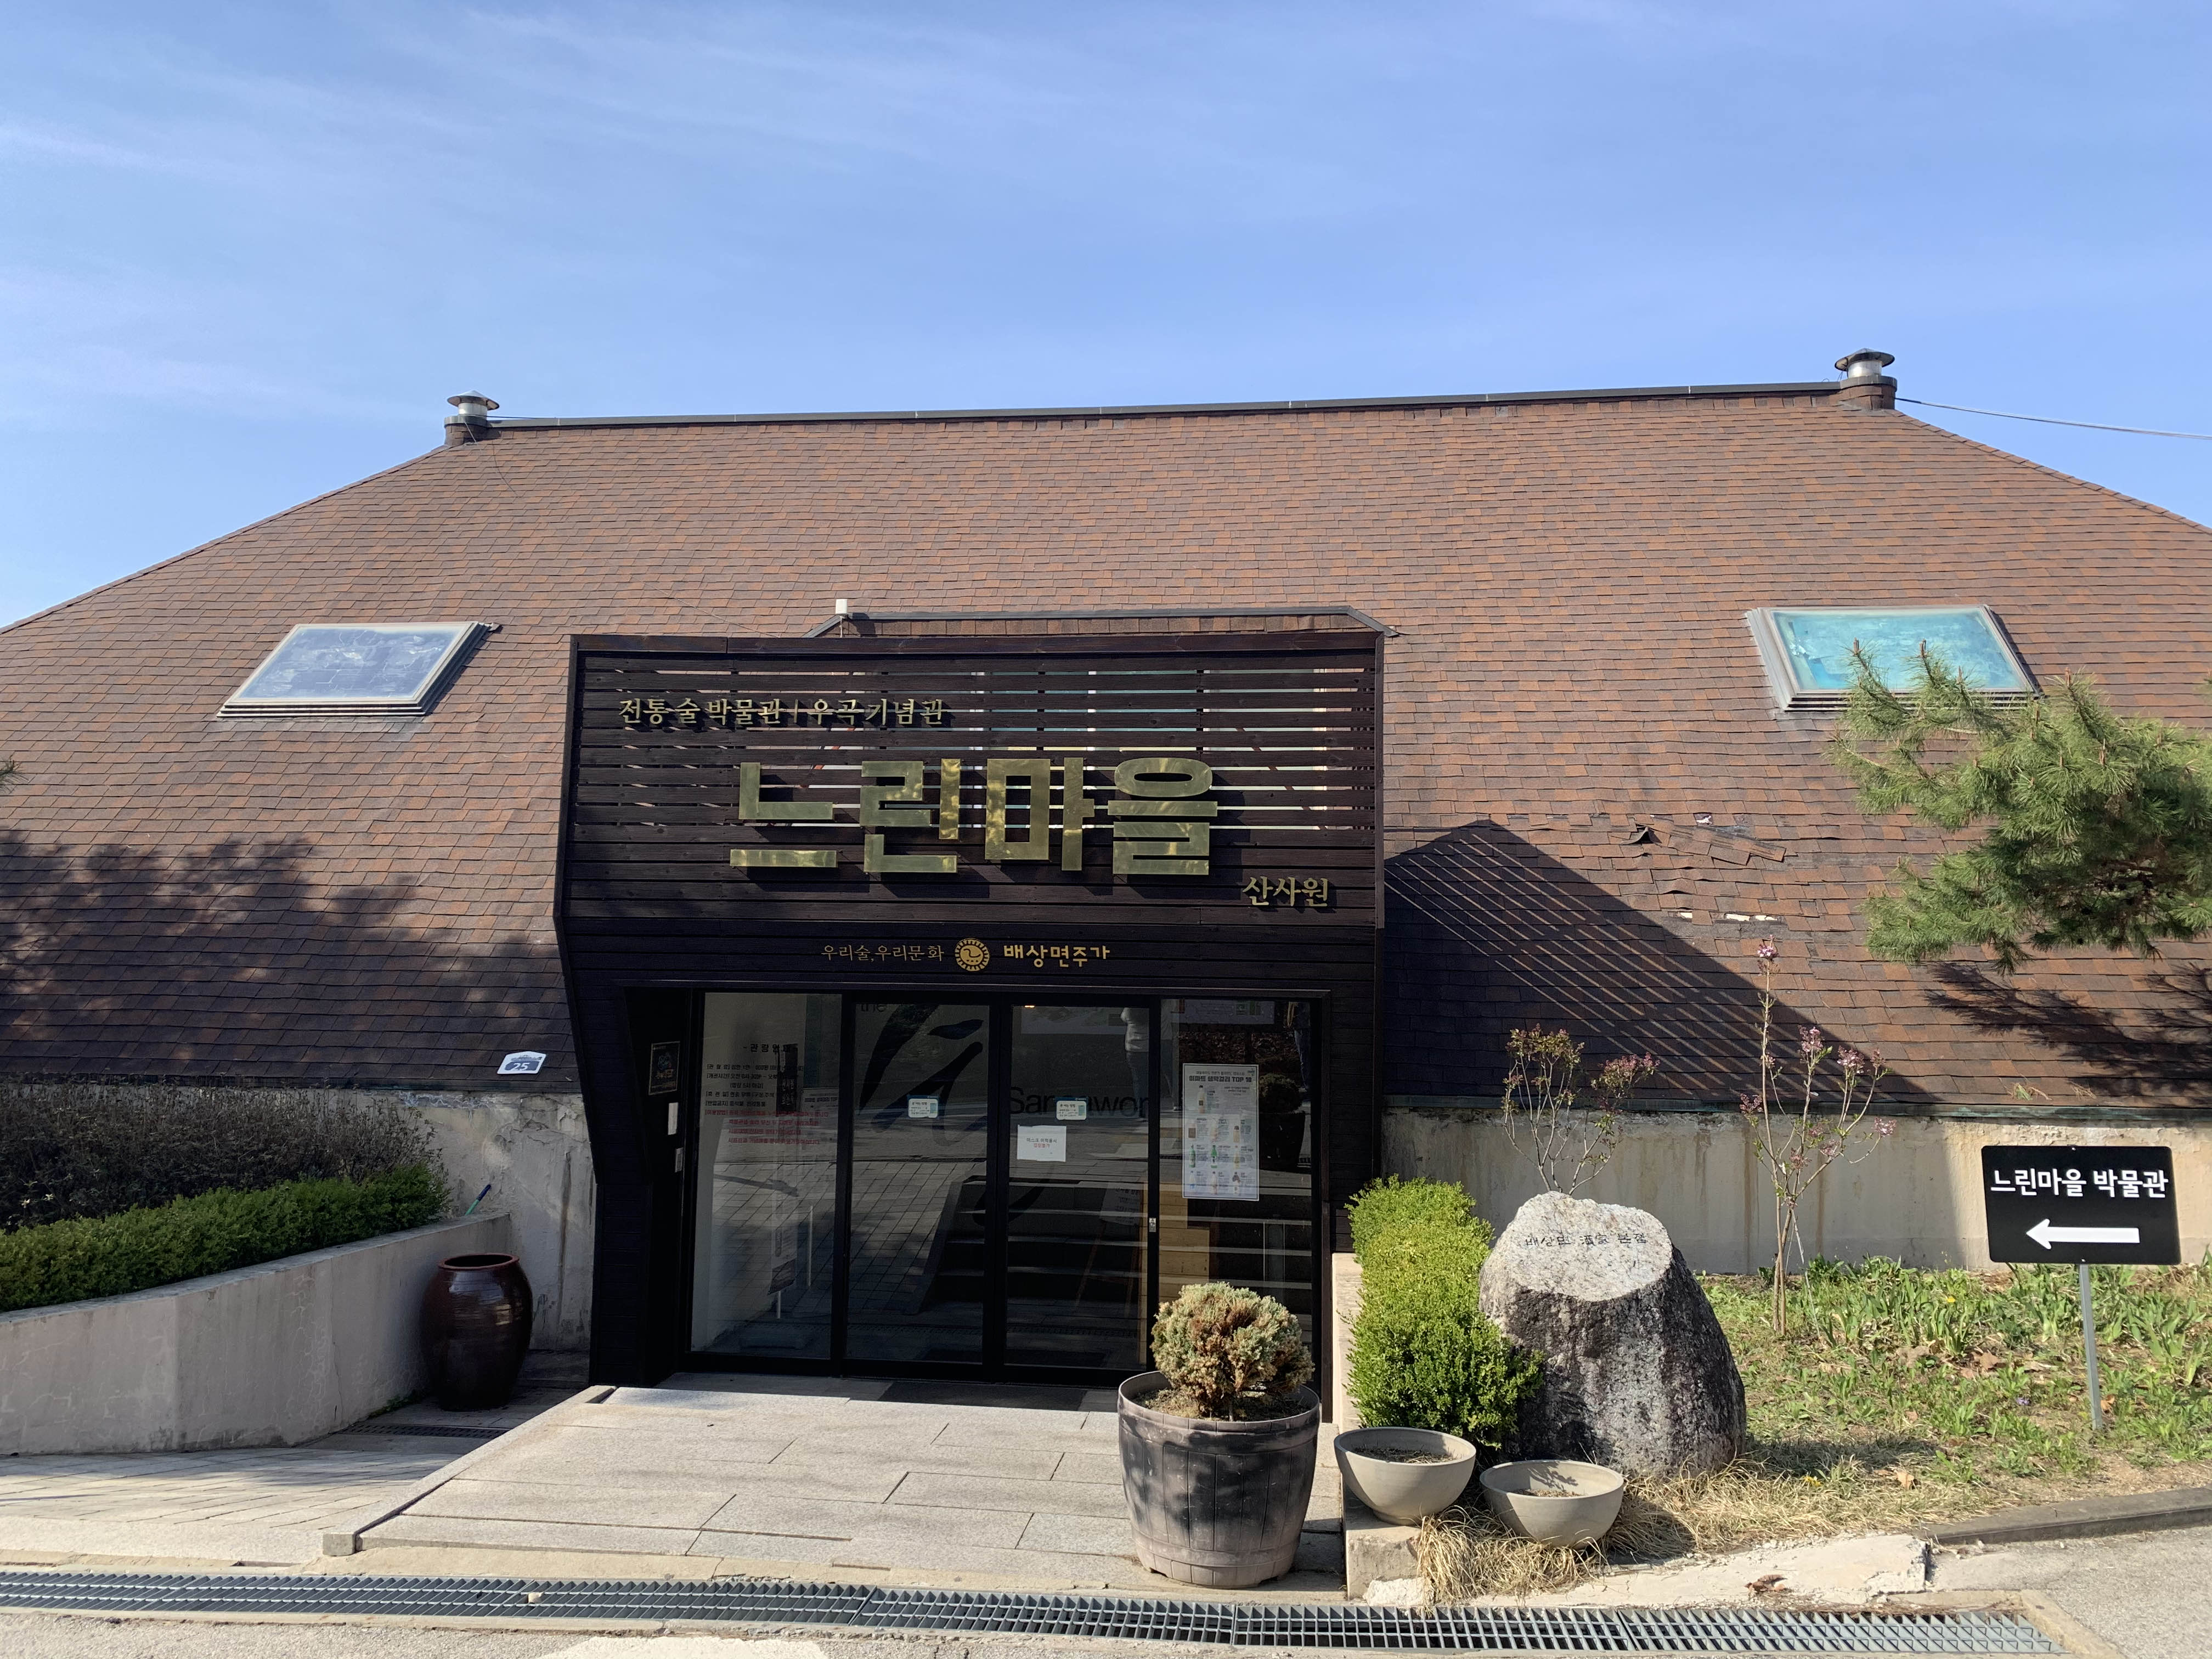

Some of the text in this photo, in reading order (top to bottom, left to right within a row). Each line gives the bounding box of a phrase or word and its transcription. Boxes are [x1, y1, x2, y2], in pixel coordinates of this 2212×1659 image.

[730, 757, 1218, 875] 느린마을
[1242, 876, 1328, 907] 산사원
[1003, 944, 1111, 968] 배상면주가
[511, 1062, 530, 1070] 25
[1990, 1168, 2169, 1198] 느린마을 박물관
